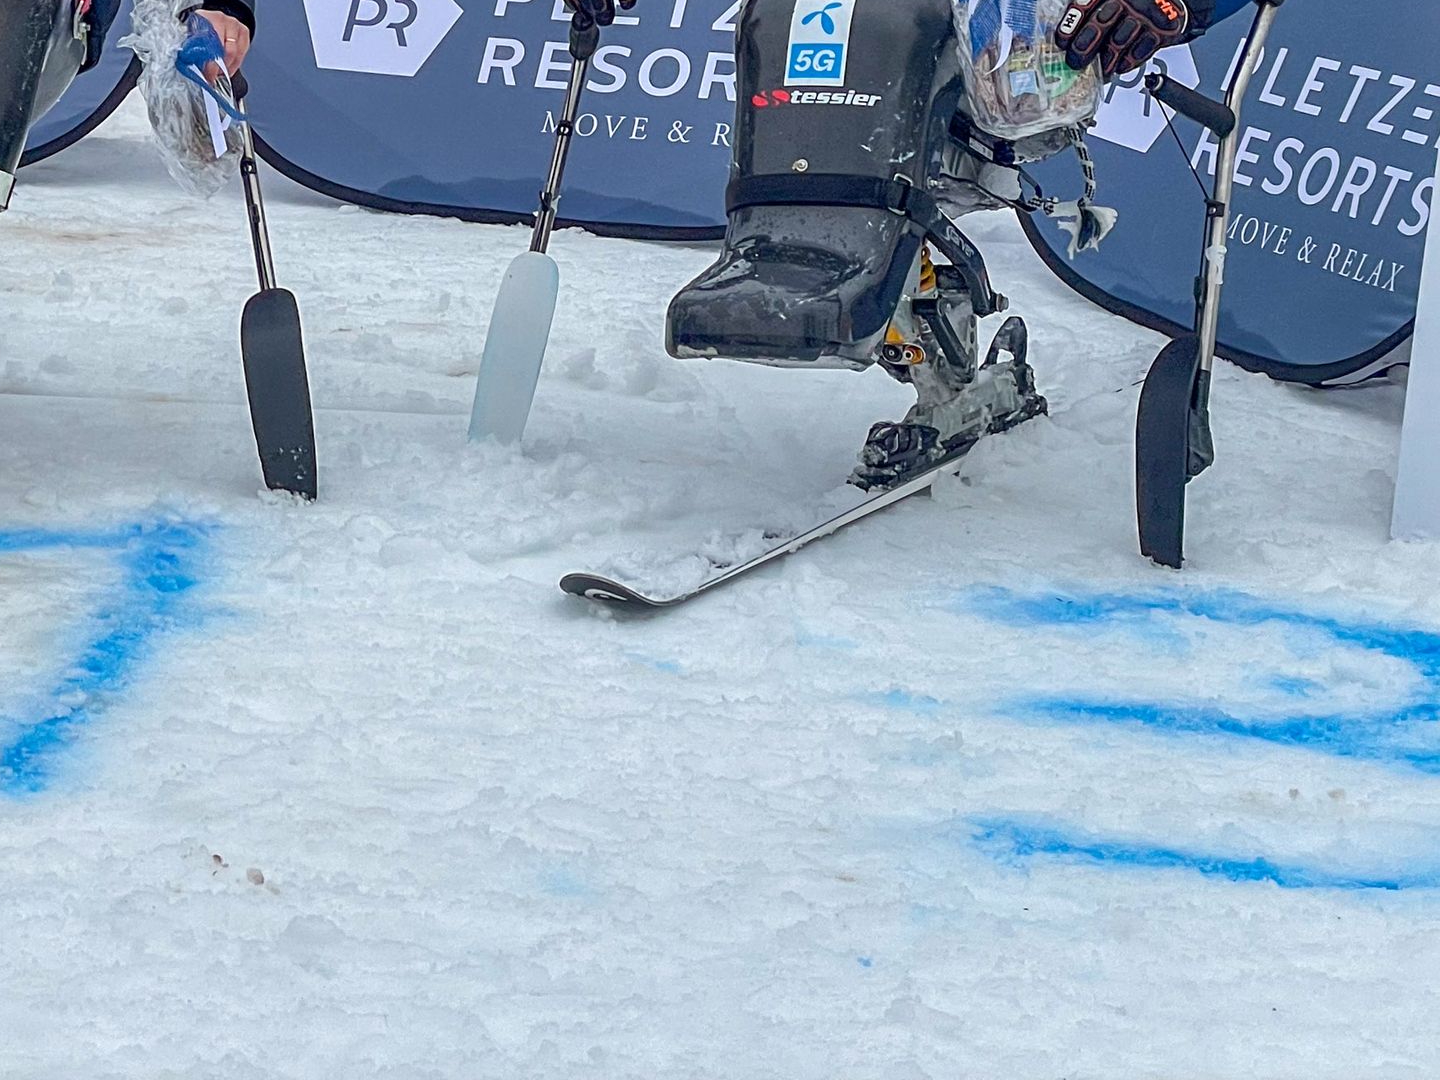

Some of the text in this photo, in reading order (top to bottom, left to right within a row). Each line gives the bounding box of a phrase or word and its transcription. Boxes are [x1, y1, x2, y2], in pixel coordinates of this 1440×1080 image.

[793, 49, 836, 72] 5G
[790, 89, 882, 107] tessier
[667, 120, 694, 144] &
[1297, 236, 1318, 264] &
[1322, 242, 1405, 292] RELAX
